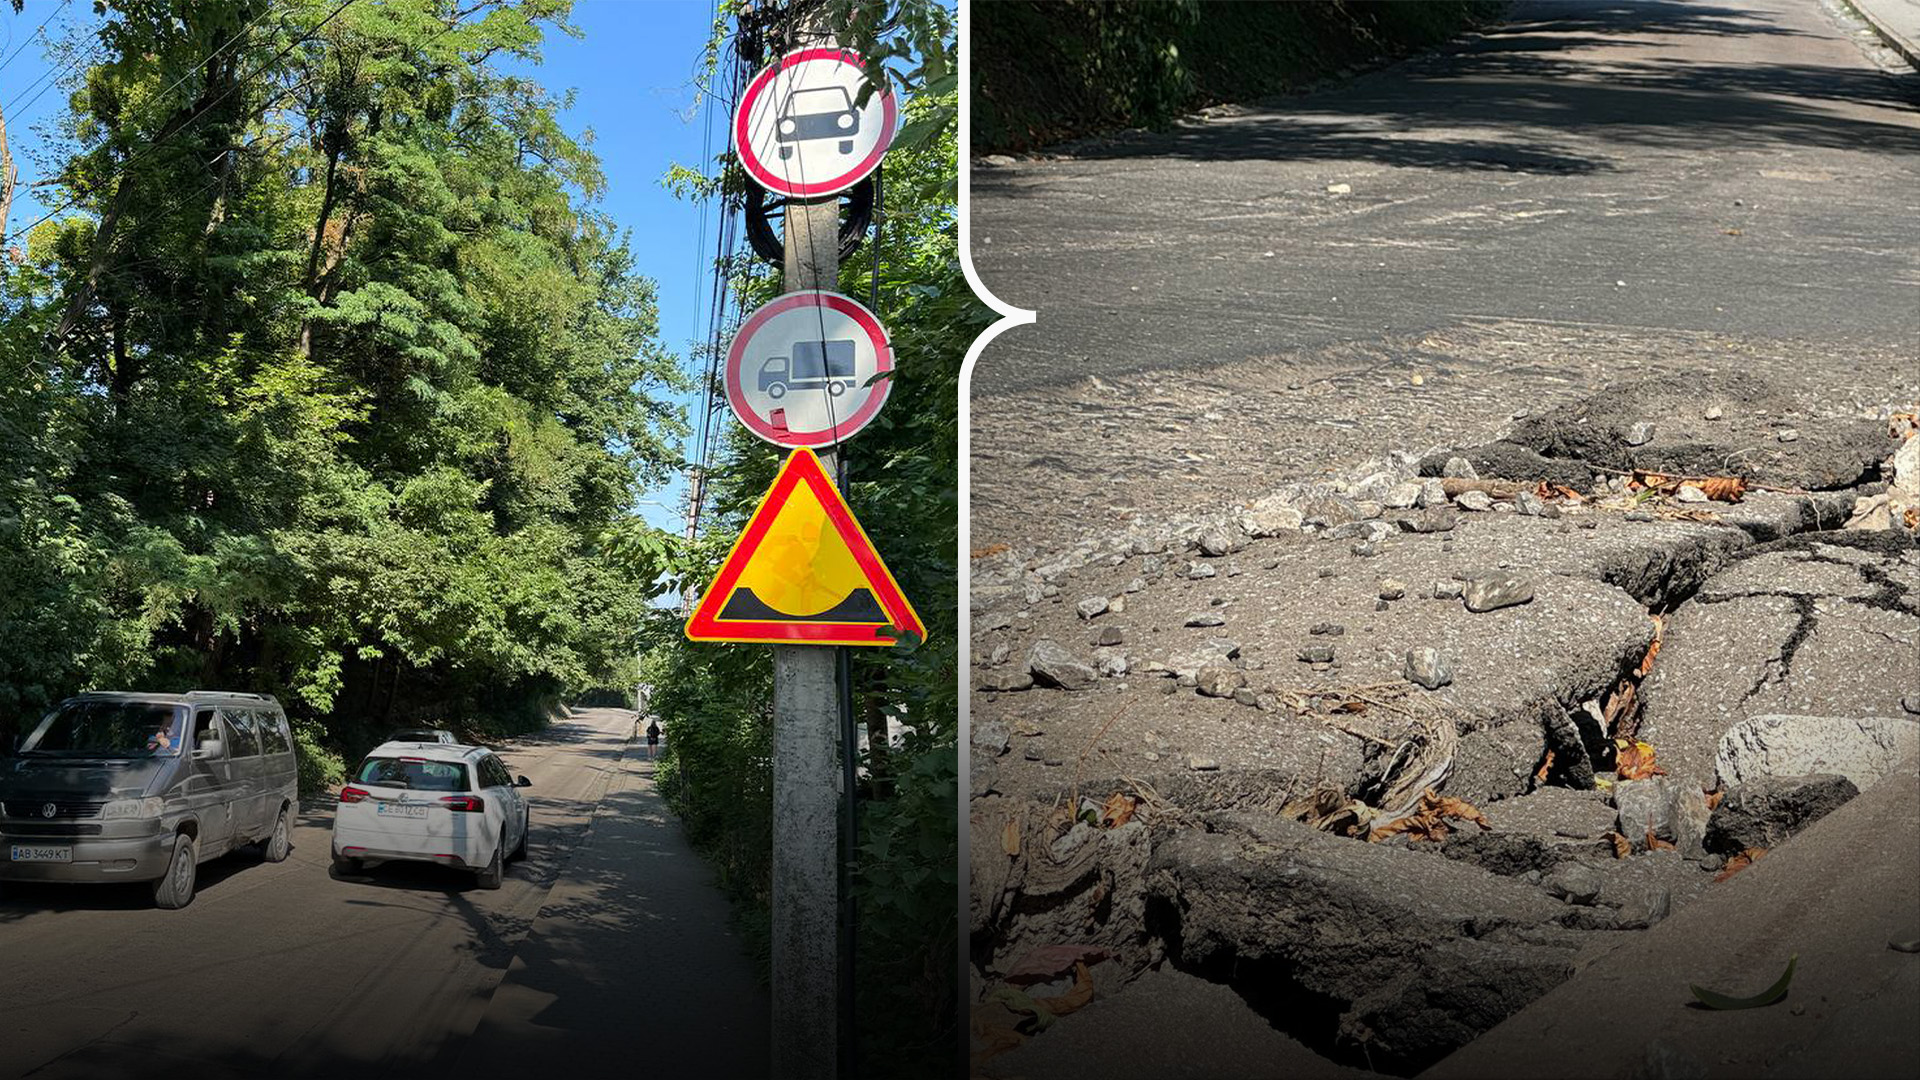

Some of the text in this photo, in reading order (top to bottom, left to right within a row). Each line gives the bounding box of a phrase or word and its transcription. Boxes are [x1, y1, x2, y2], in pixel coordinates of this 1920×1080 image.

[18, 848, 69, 860] AB 3449 KT
